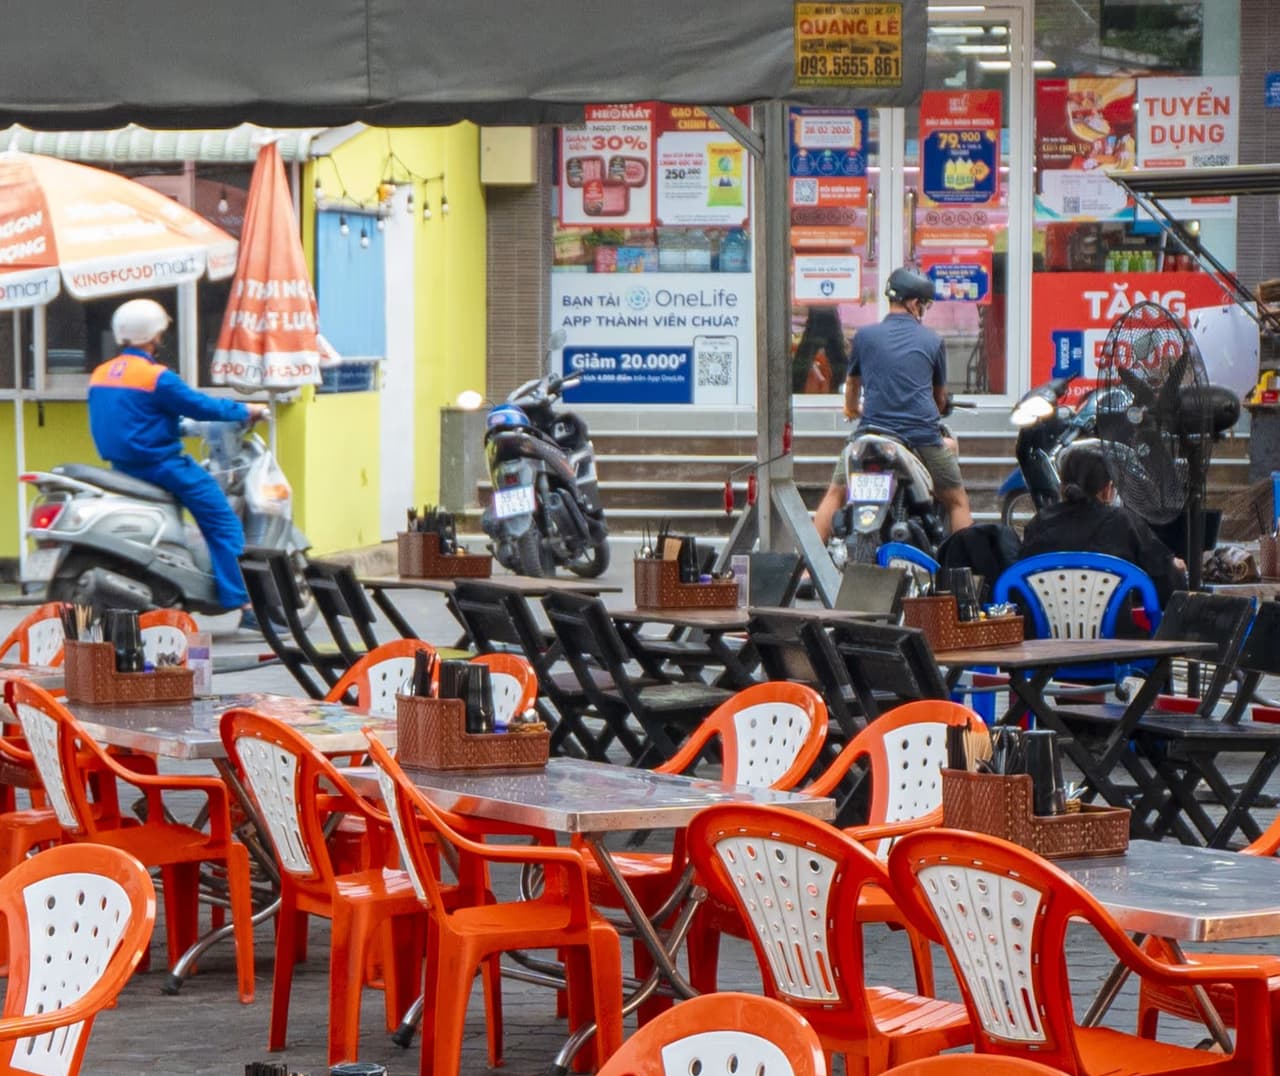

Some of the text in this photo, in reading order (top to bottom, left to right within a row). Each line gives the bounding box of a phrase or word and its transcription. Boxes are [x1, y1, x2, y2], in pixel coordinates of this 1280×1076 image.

[800, 15, 899, 36] QUANG LÊ
[800, 55, 900, 76] 093.5555.861
[1144, 86, 1231, 117] TUYỂN
[591, 135, 648, 151] 30%
[1150, 124, 1225, 150] DỤNG
[664, 169, 686, 180] 250
[562, 295, 593, 310] BẠN
[655, 288, 738, 307] OneLife
[562, 312, 740, 327] APP THÀNH VIÊN CHƯA?
[571, 352, 616, 370] Giảm
